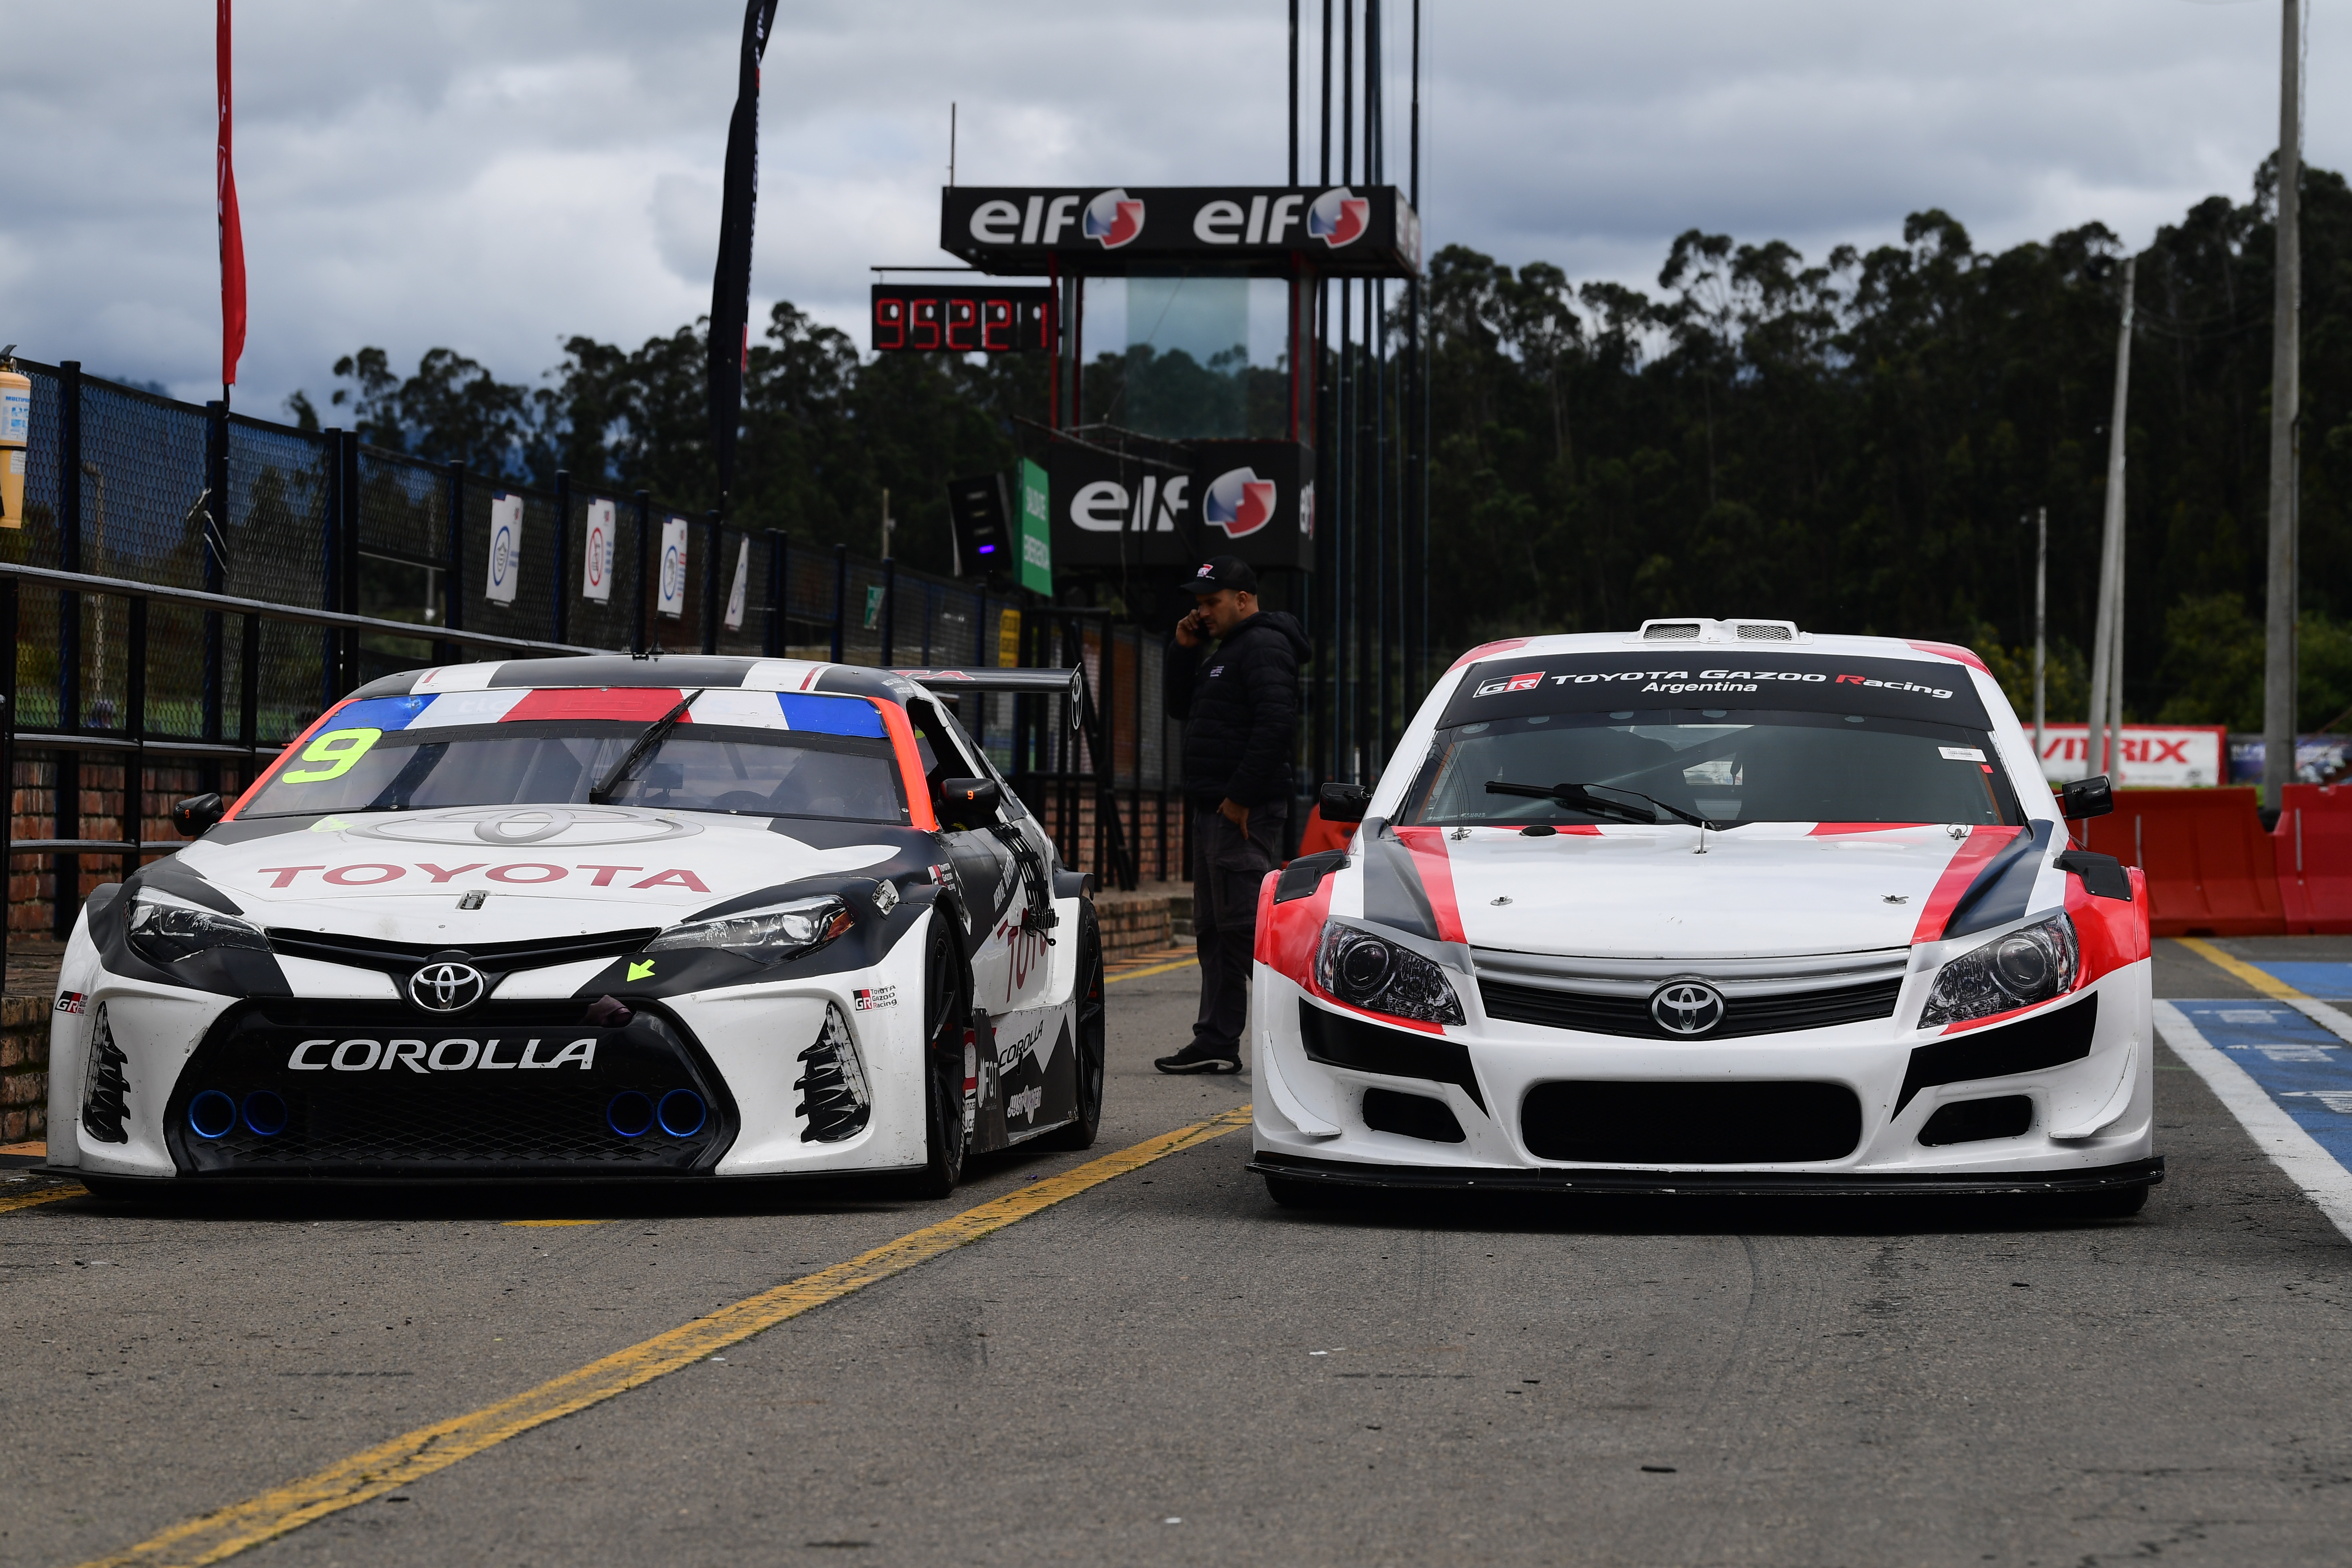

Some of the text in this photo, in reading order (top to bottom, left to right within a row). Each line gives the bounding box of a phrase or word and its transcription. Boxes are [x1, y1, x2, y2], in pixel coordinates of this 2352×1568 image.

[969, 195, 1080, 244] elf
[1192, 194, 1304, 244] elf
[1070, 475, 1189, 532] elf
[1551, 671, 1688, 685] TOYOTA
[1699, 670, 1827, 682] GAZOO
[1835, 674, 1954, 699] Racing
[1641, 681, 1758, 694] Argentina
[282, 727, 382, 784] 9
[967, 790, 974, 800] 9
[257, 863, 712, 893] TOYOTA
[855, 997, 871, 1010] GR
[870, 985, 896, 995] TOYOTA
[872, 992, 895, 1002] GAZOO
[873, 999, 897, 1008] Racing
[57, 999, 79, 1013] GR
[288, 1038, 597, 1073] COROLLA
[999, 1019, 1044, 1067] COROLLA
